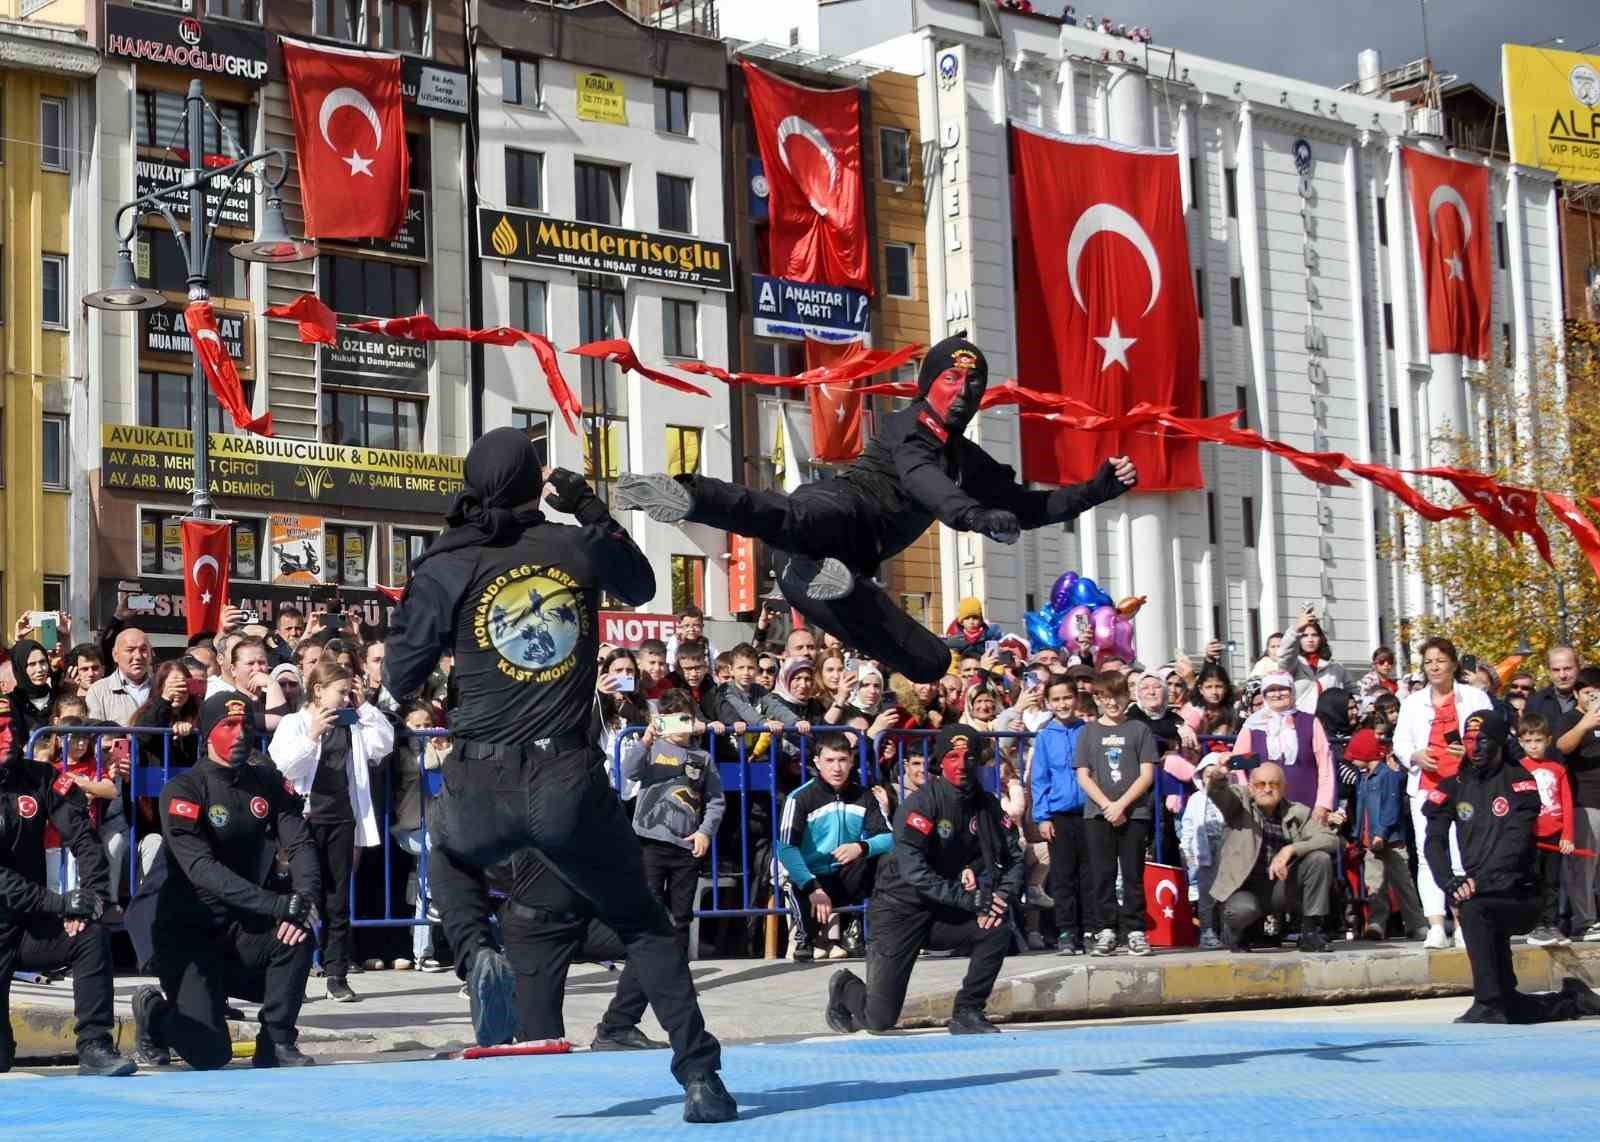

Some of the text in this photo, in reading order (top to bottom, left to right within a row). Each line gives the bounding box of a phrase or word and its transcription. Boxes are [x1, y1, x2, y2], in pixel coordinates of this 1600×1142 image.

[1549, 143, 1600, 160] VIP PLUS
[558, 253, 592, 267] EMLAK
[593, 257, 601, 268] &
[759, 281, 776, 306] A
[785, 286, 843, 307] ANAHTAR
[174, 313, 241, 339] AAT
[149, 332, 193, 353] MUAMM
[342, 336, 384, 355] ÖZLEM
[164, 455, 215, 473] MEHT
[222, 438, 346, 463] ARABULUCULUK
[351, 448, 362, 465] &
[367, 451, 465, 474] DANIŞMANLI
[164, 475, 220, 493] MUSTA
[222, 479, 275, 497] DEMİRCİ
[368, 472, 403, 490] ŞAMİL
[405, 476, 436, 492] EMRE
[438, 478, 465, 497] ÇİFT
[474, 575, 508, 649] KOMANDO
[497, 654, 578, 683] KASTMONU
